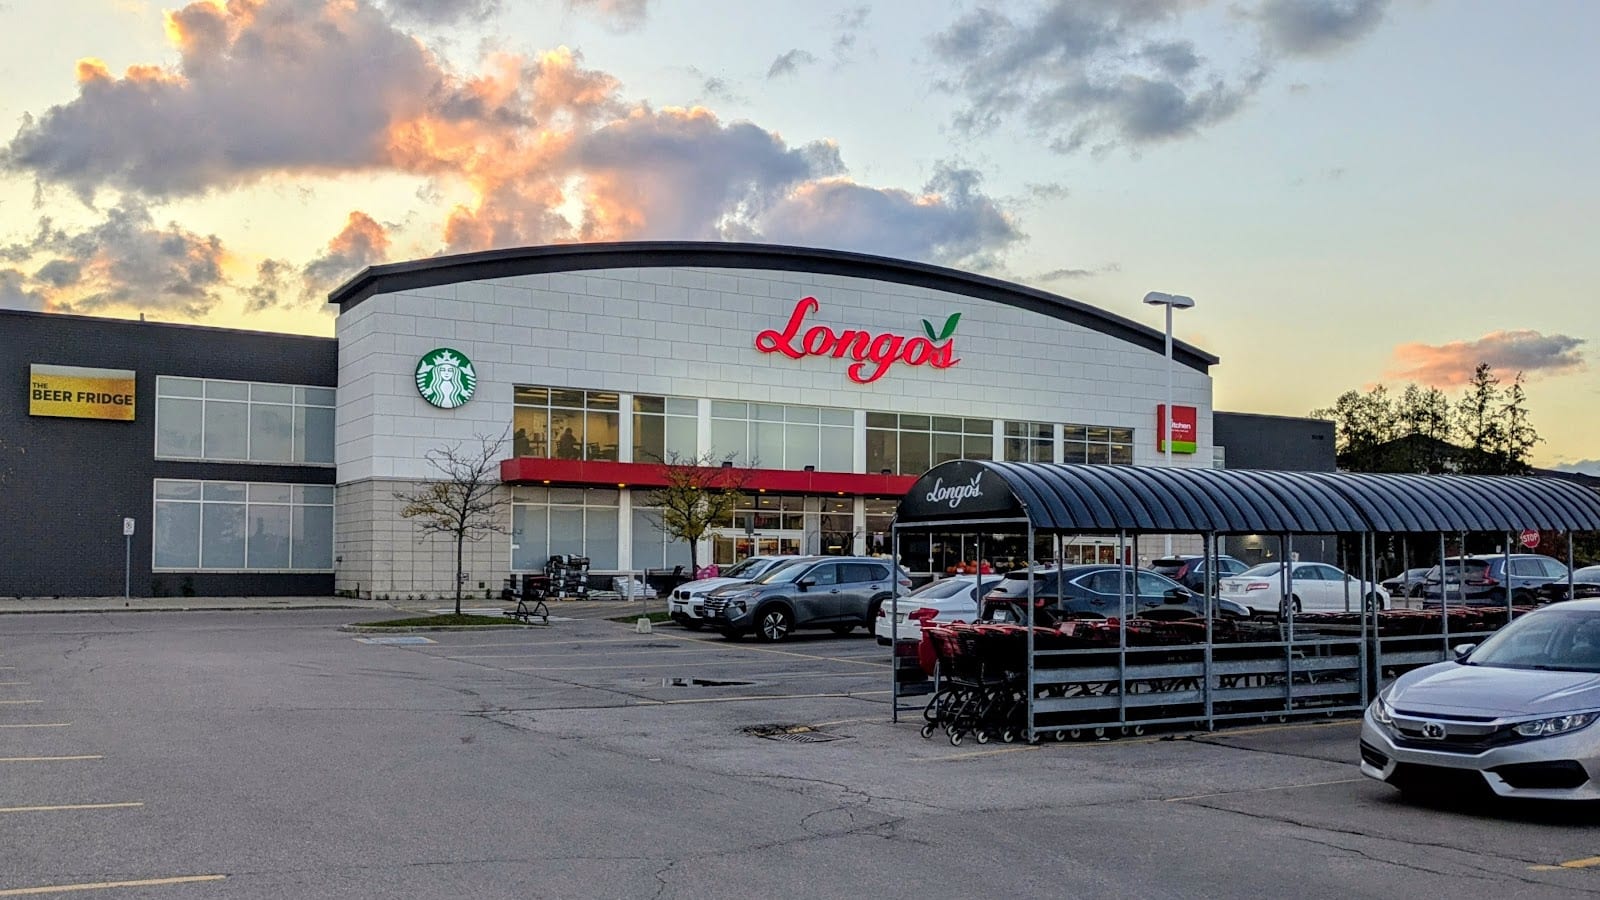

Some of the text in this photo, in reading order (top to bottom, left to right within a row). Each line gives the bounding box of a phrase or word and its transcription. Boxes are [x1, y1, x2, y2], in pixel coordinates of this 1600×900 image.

[32, 389, 134, 406] BEER FRIDGE
[1522, 533, 1538, 543] STOP
